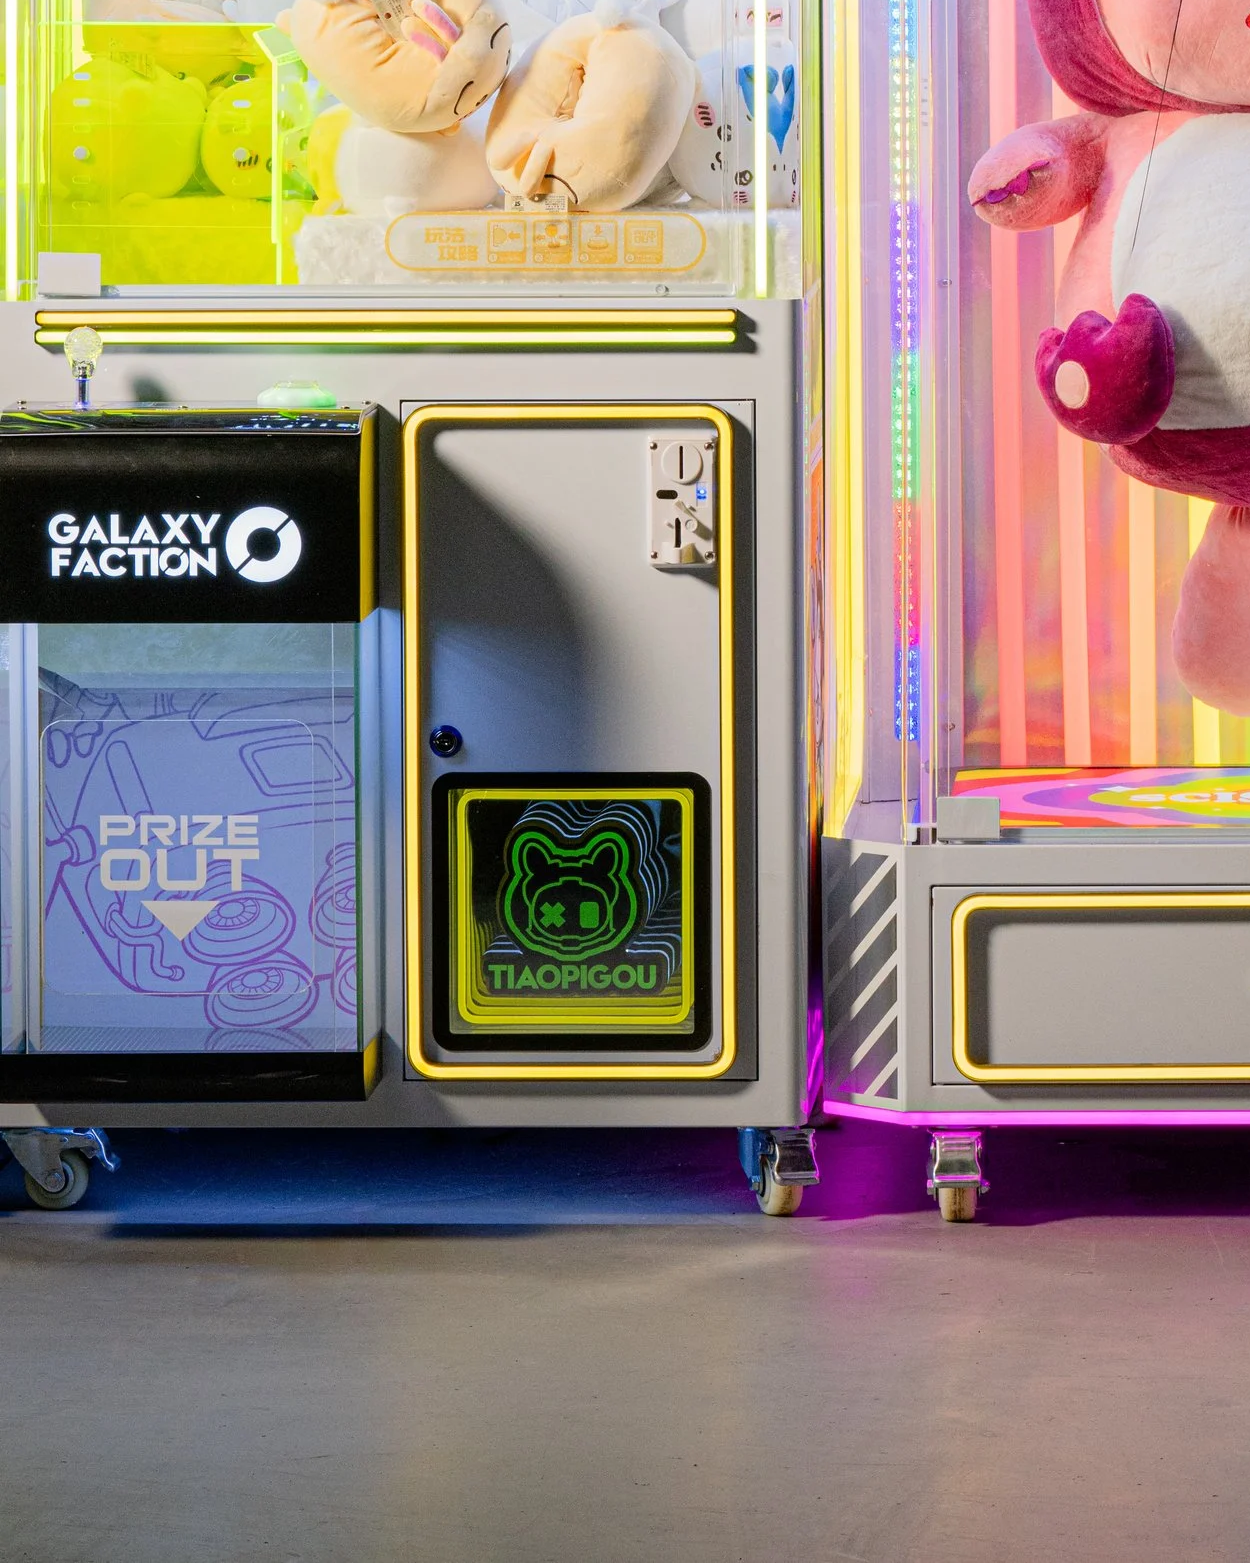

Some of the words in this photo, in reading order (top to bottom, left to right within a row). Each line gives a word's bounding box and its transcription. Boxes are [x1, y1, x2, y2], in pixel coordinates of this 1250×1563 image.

[48, 514, 221, 544] GALAXY
[51, 547, 217, 577] FACTION
[99, 815, 260, 846] PRIZE
[99, 848, 260, 892] OUT
[488, 964, 657, 990] TIAOPIGOU
